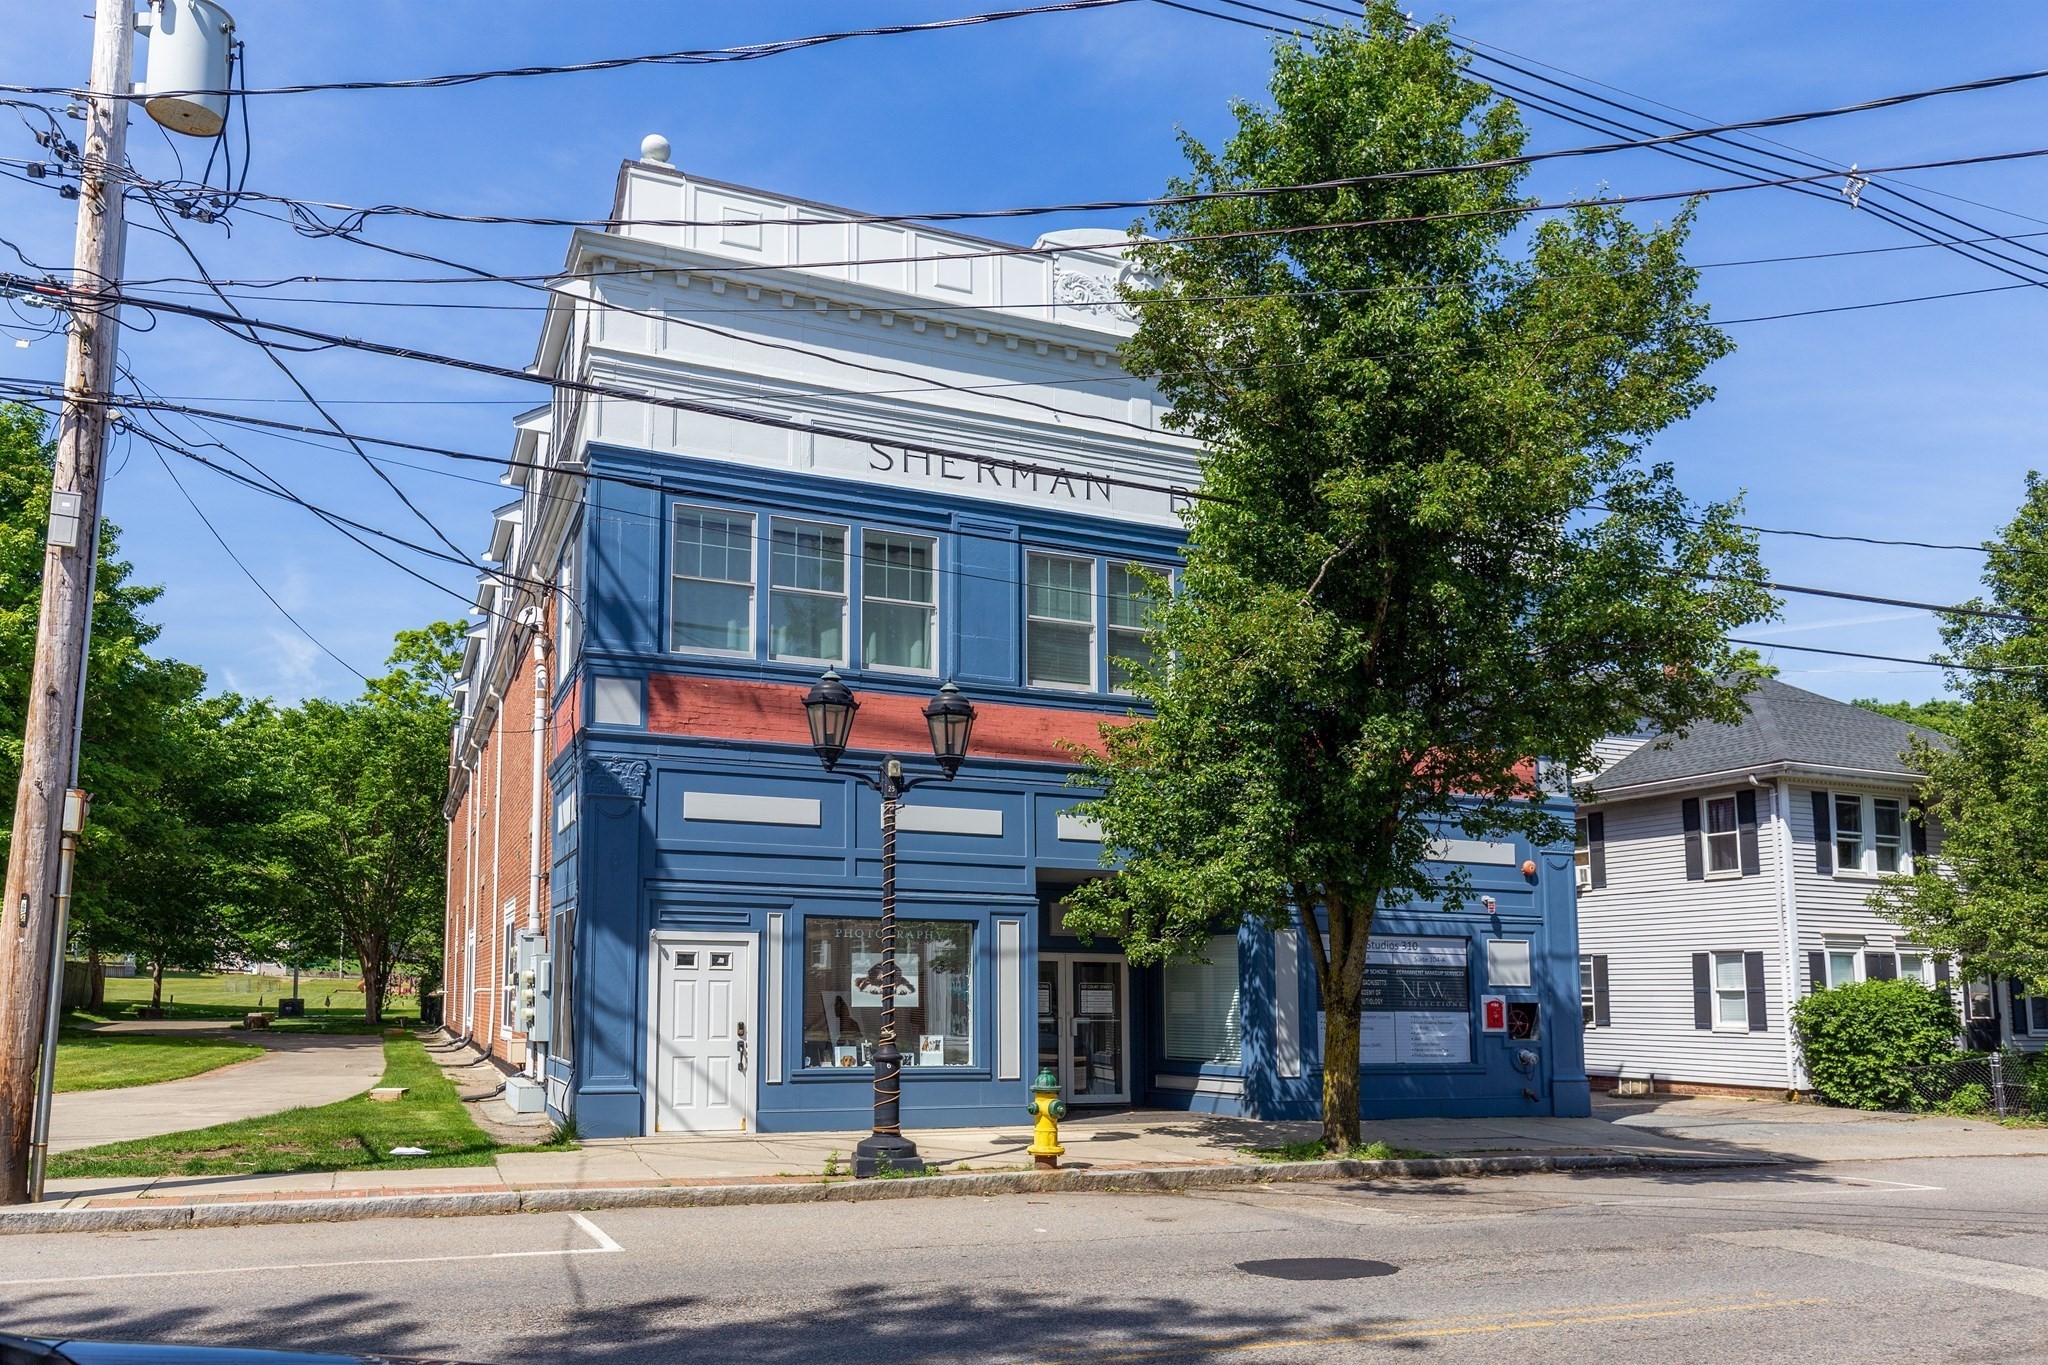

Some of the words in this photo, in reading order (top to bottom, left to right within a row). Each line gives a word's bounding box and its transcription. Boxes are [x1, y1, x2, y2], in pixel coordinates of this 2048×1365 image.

[869, 442, 1112, 503] SHERMAN
[887, 785, 896, 793] 25
[835, 928, 944, 939] PHOTORAPHY
[1366, 939, 1399, 950] Studios
[1401, 941, 1418, 951] 310
[1399, 978, 1447, 1000] NEW
[1402, 1000, 1464, 1008] REFLECTIONS
